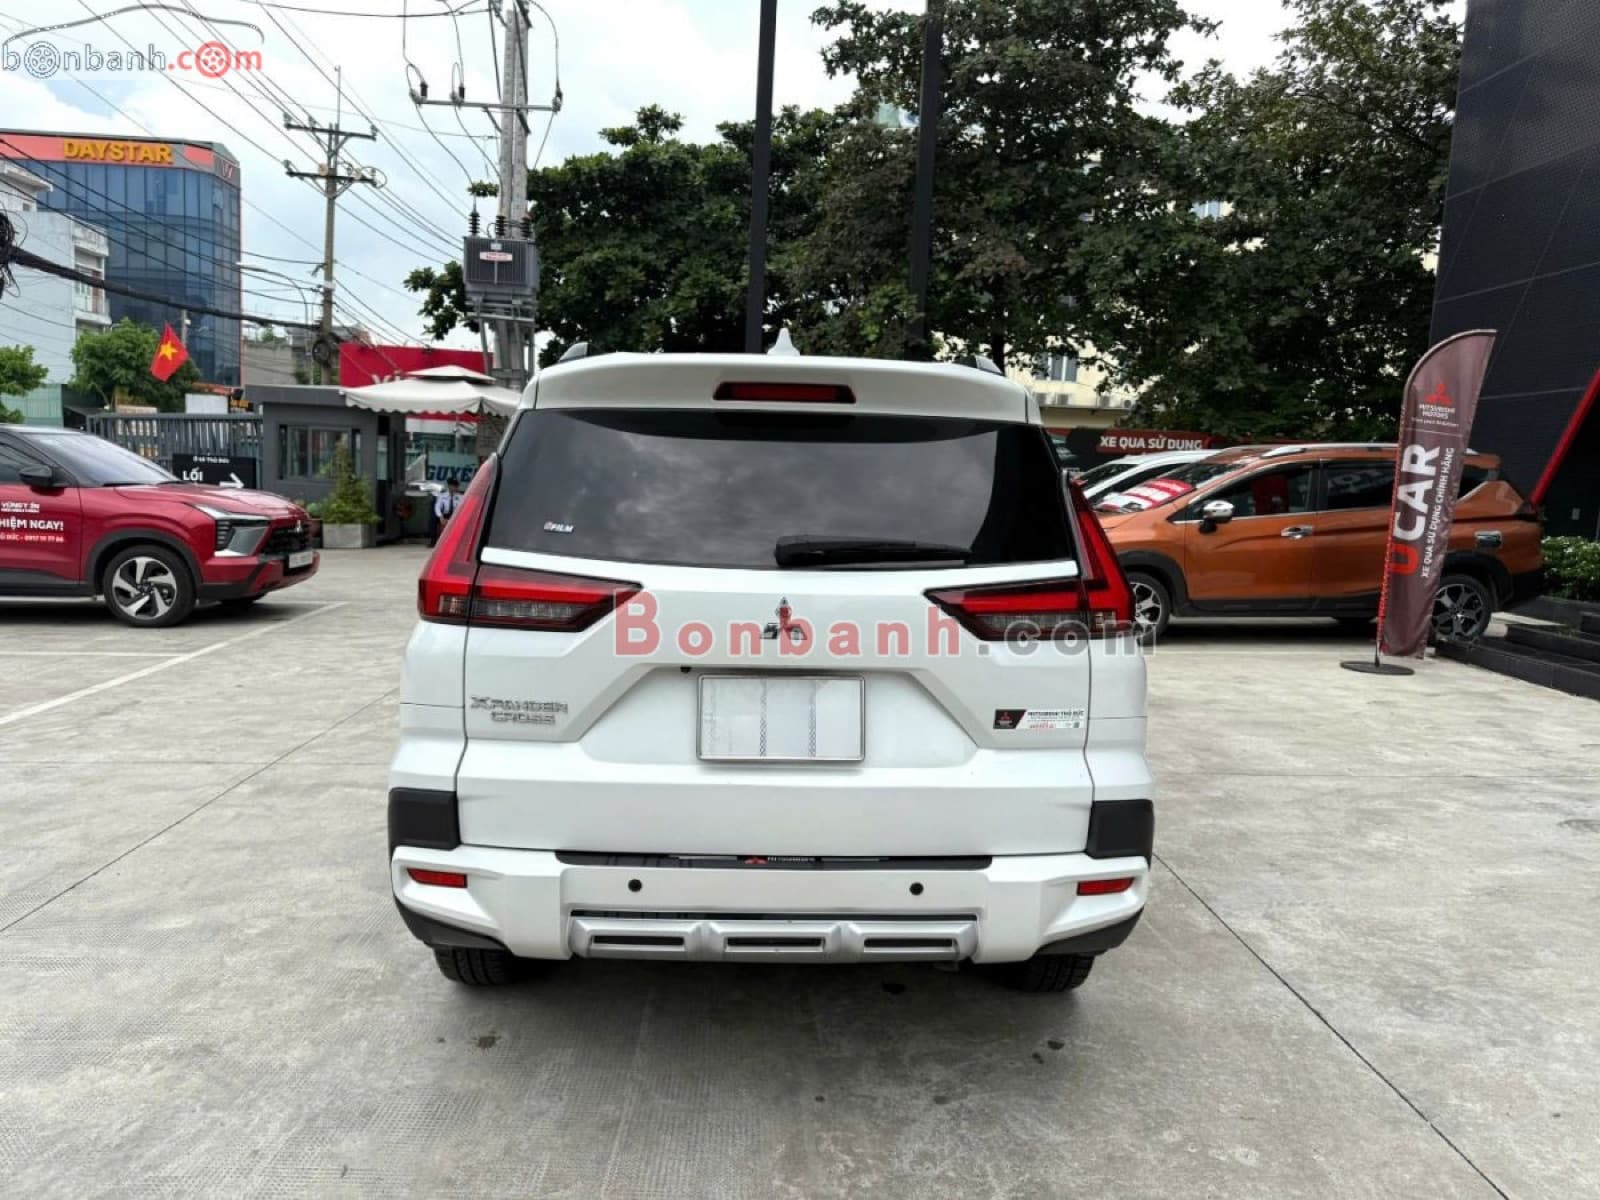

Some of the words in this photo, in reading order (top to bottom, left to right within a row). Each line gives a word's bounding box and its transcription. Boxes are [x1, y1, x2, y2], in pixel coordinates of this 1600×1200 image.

[63, 140, 173, 163] DAYSTAR
[1100, 435, 1117, 448] XE
[1119, 437, 1146, 450] QUA
[30, 519, 64, 531] NGAY!
